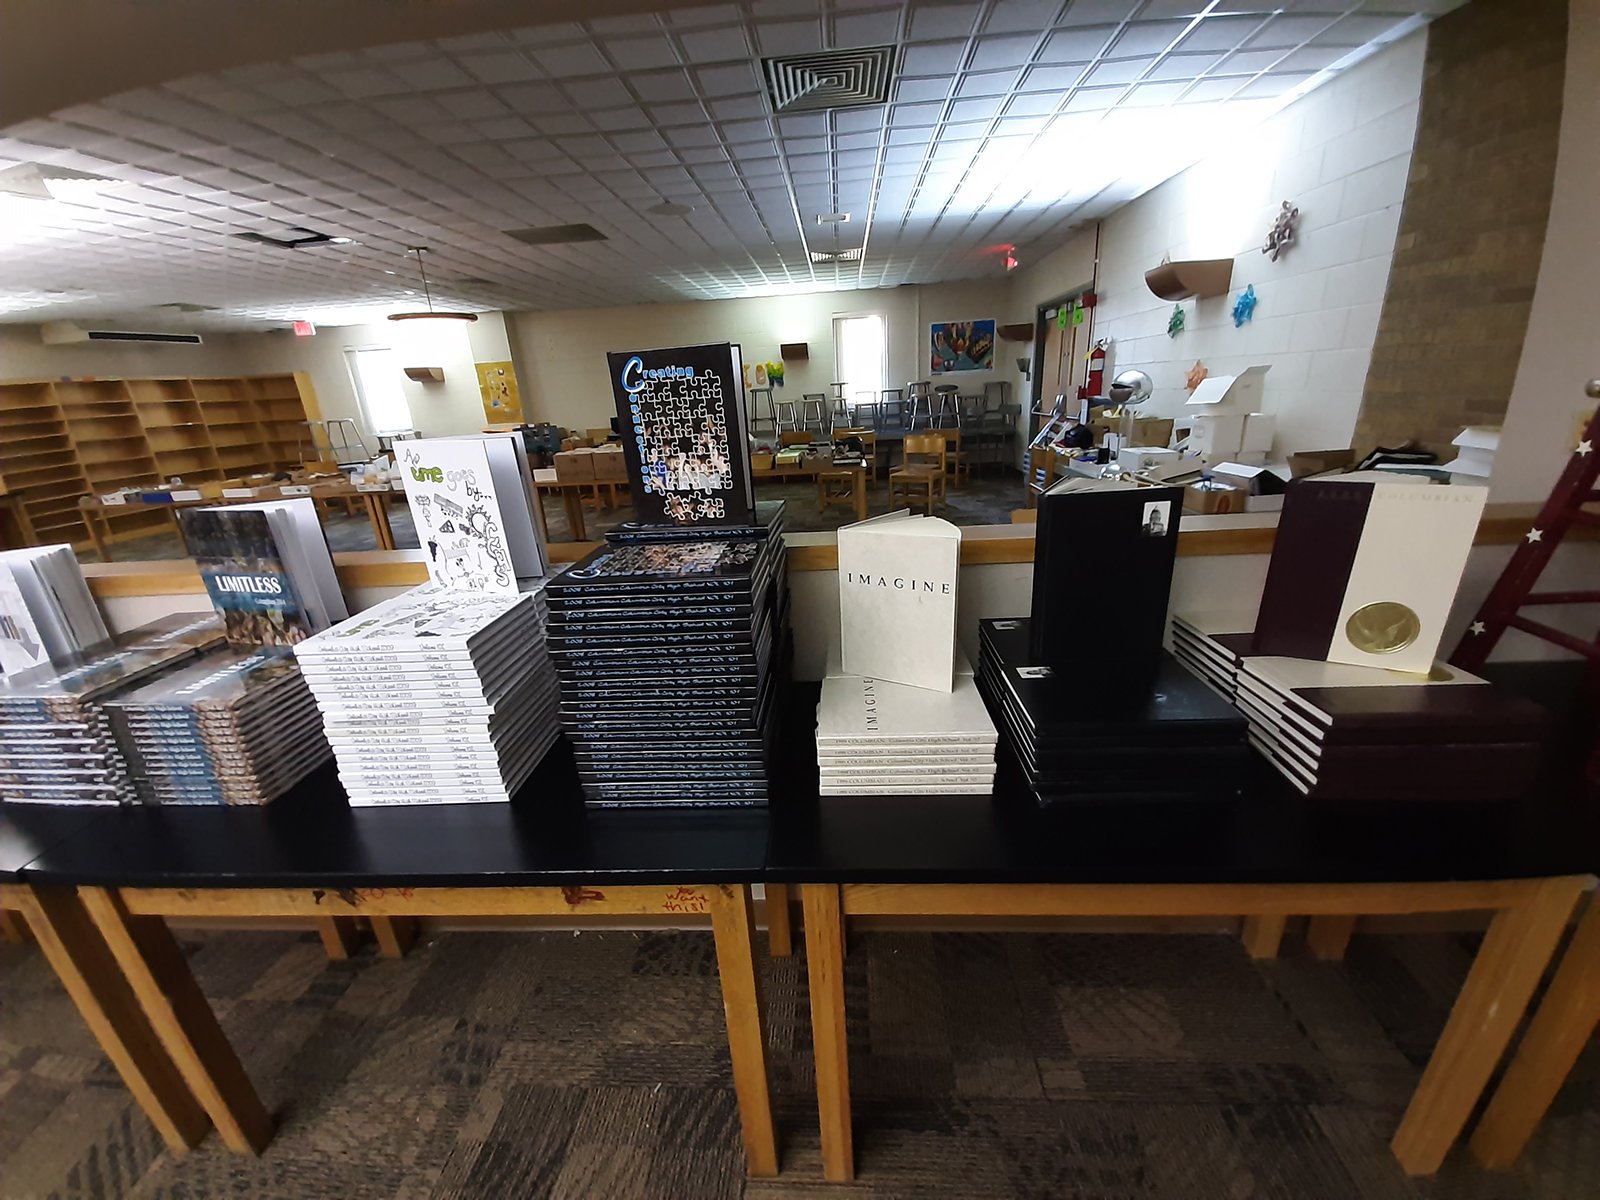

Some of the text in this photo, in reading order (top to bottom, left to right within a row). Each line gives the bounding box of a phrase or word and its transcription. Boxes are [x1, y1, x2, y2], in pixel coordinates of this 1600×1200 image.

[621, 356, 695, 393] Creating
[446, 468, 476, 491] goes
[214, 575, 282, 594] LIMITLESS
[847, 572, 951, 595] IMAGINE
[863, 679, 879, 731] IMAGINE
